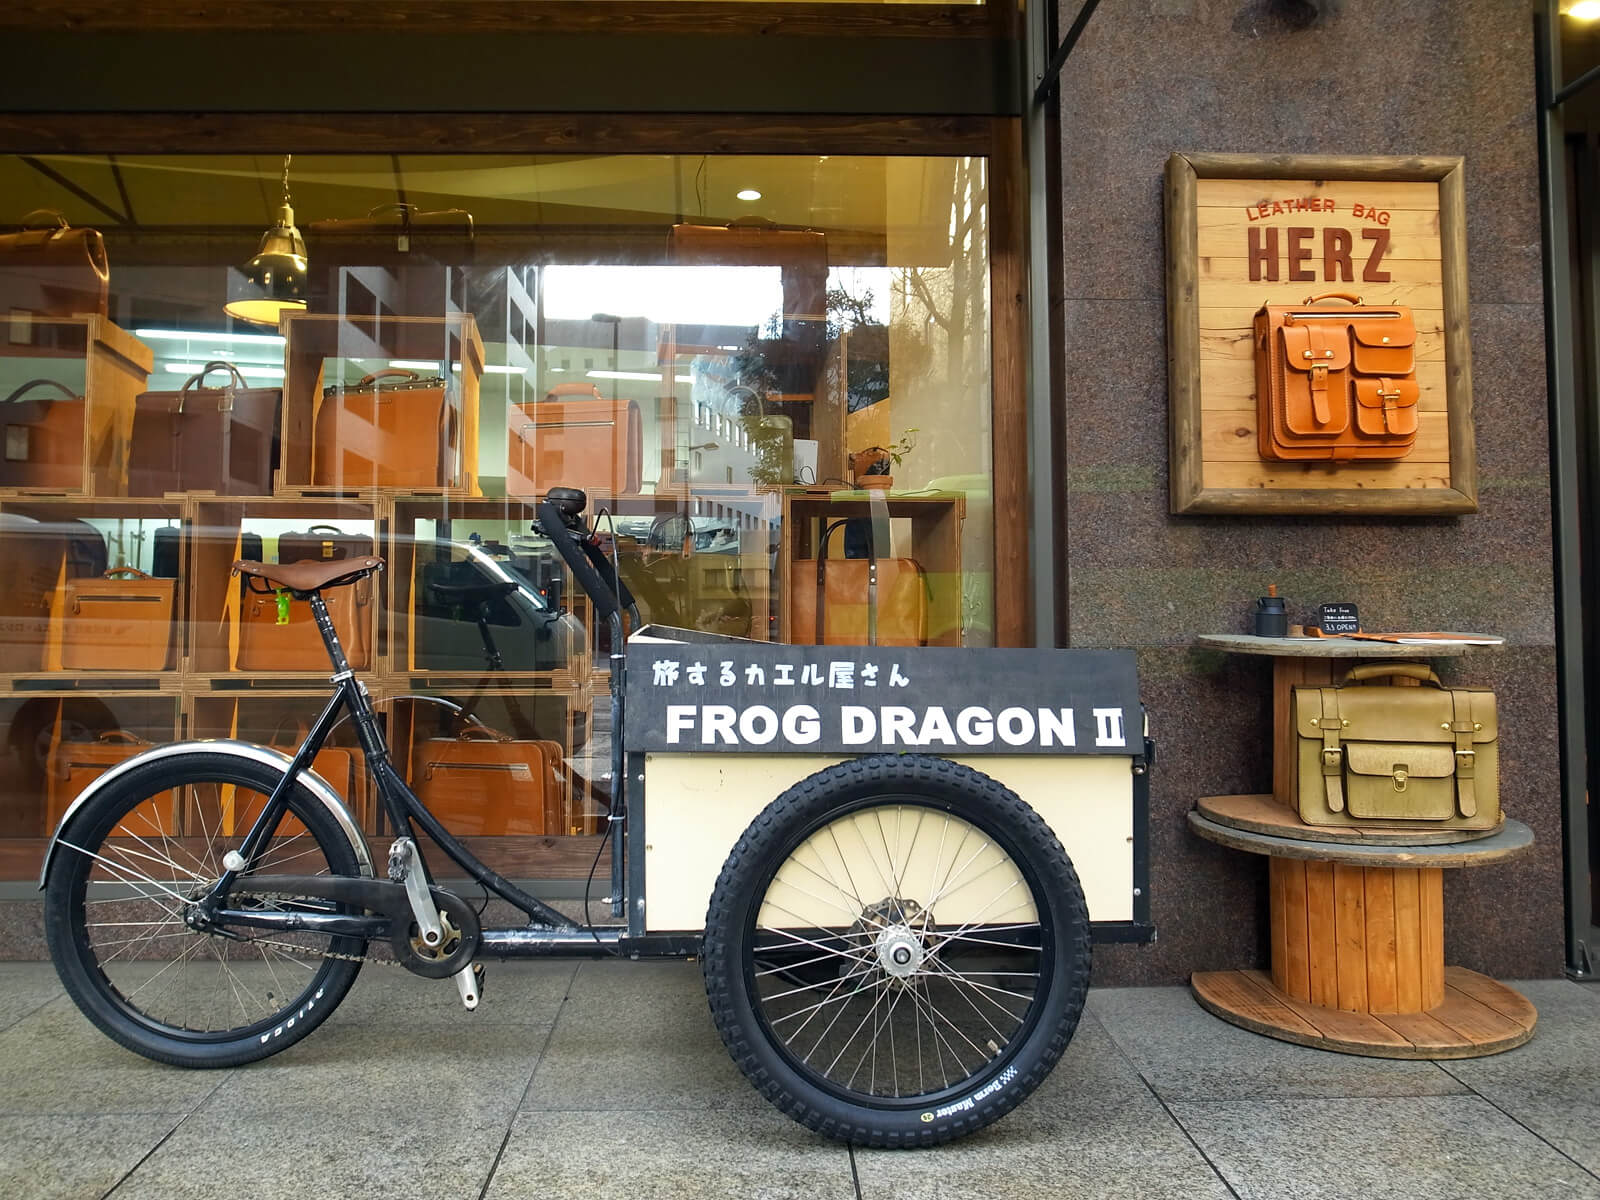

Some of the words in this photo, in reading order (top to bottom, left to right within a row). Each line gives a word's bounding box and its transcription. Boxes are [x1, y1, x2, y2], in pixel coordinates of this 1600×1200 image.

[1246, 198, 1336, 221] LEATHER
[1352, 203, 1391, 226] BAG
[1248, 227, 1391, 282] HERZ
[652, 660, 910, 689] 旅するカエル屋さん
[666, 704, 821, 745] FROG
[840, 705, 1076, 747] DRAGON
